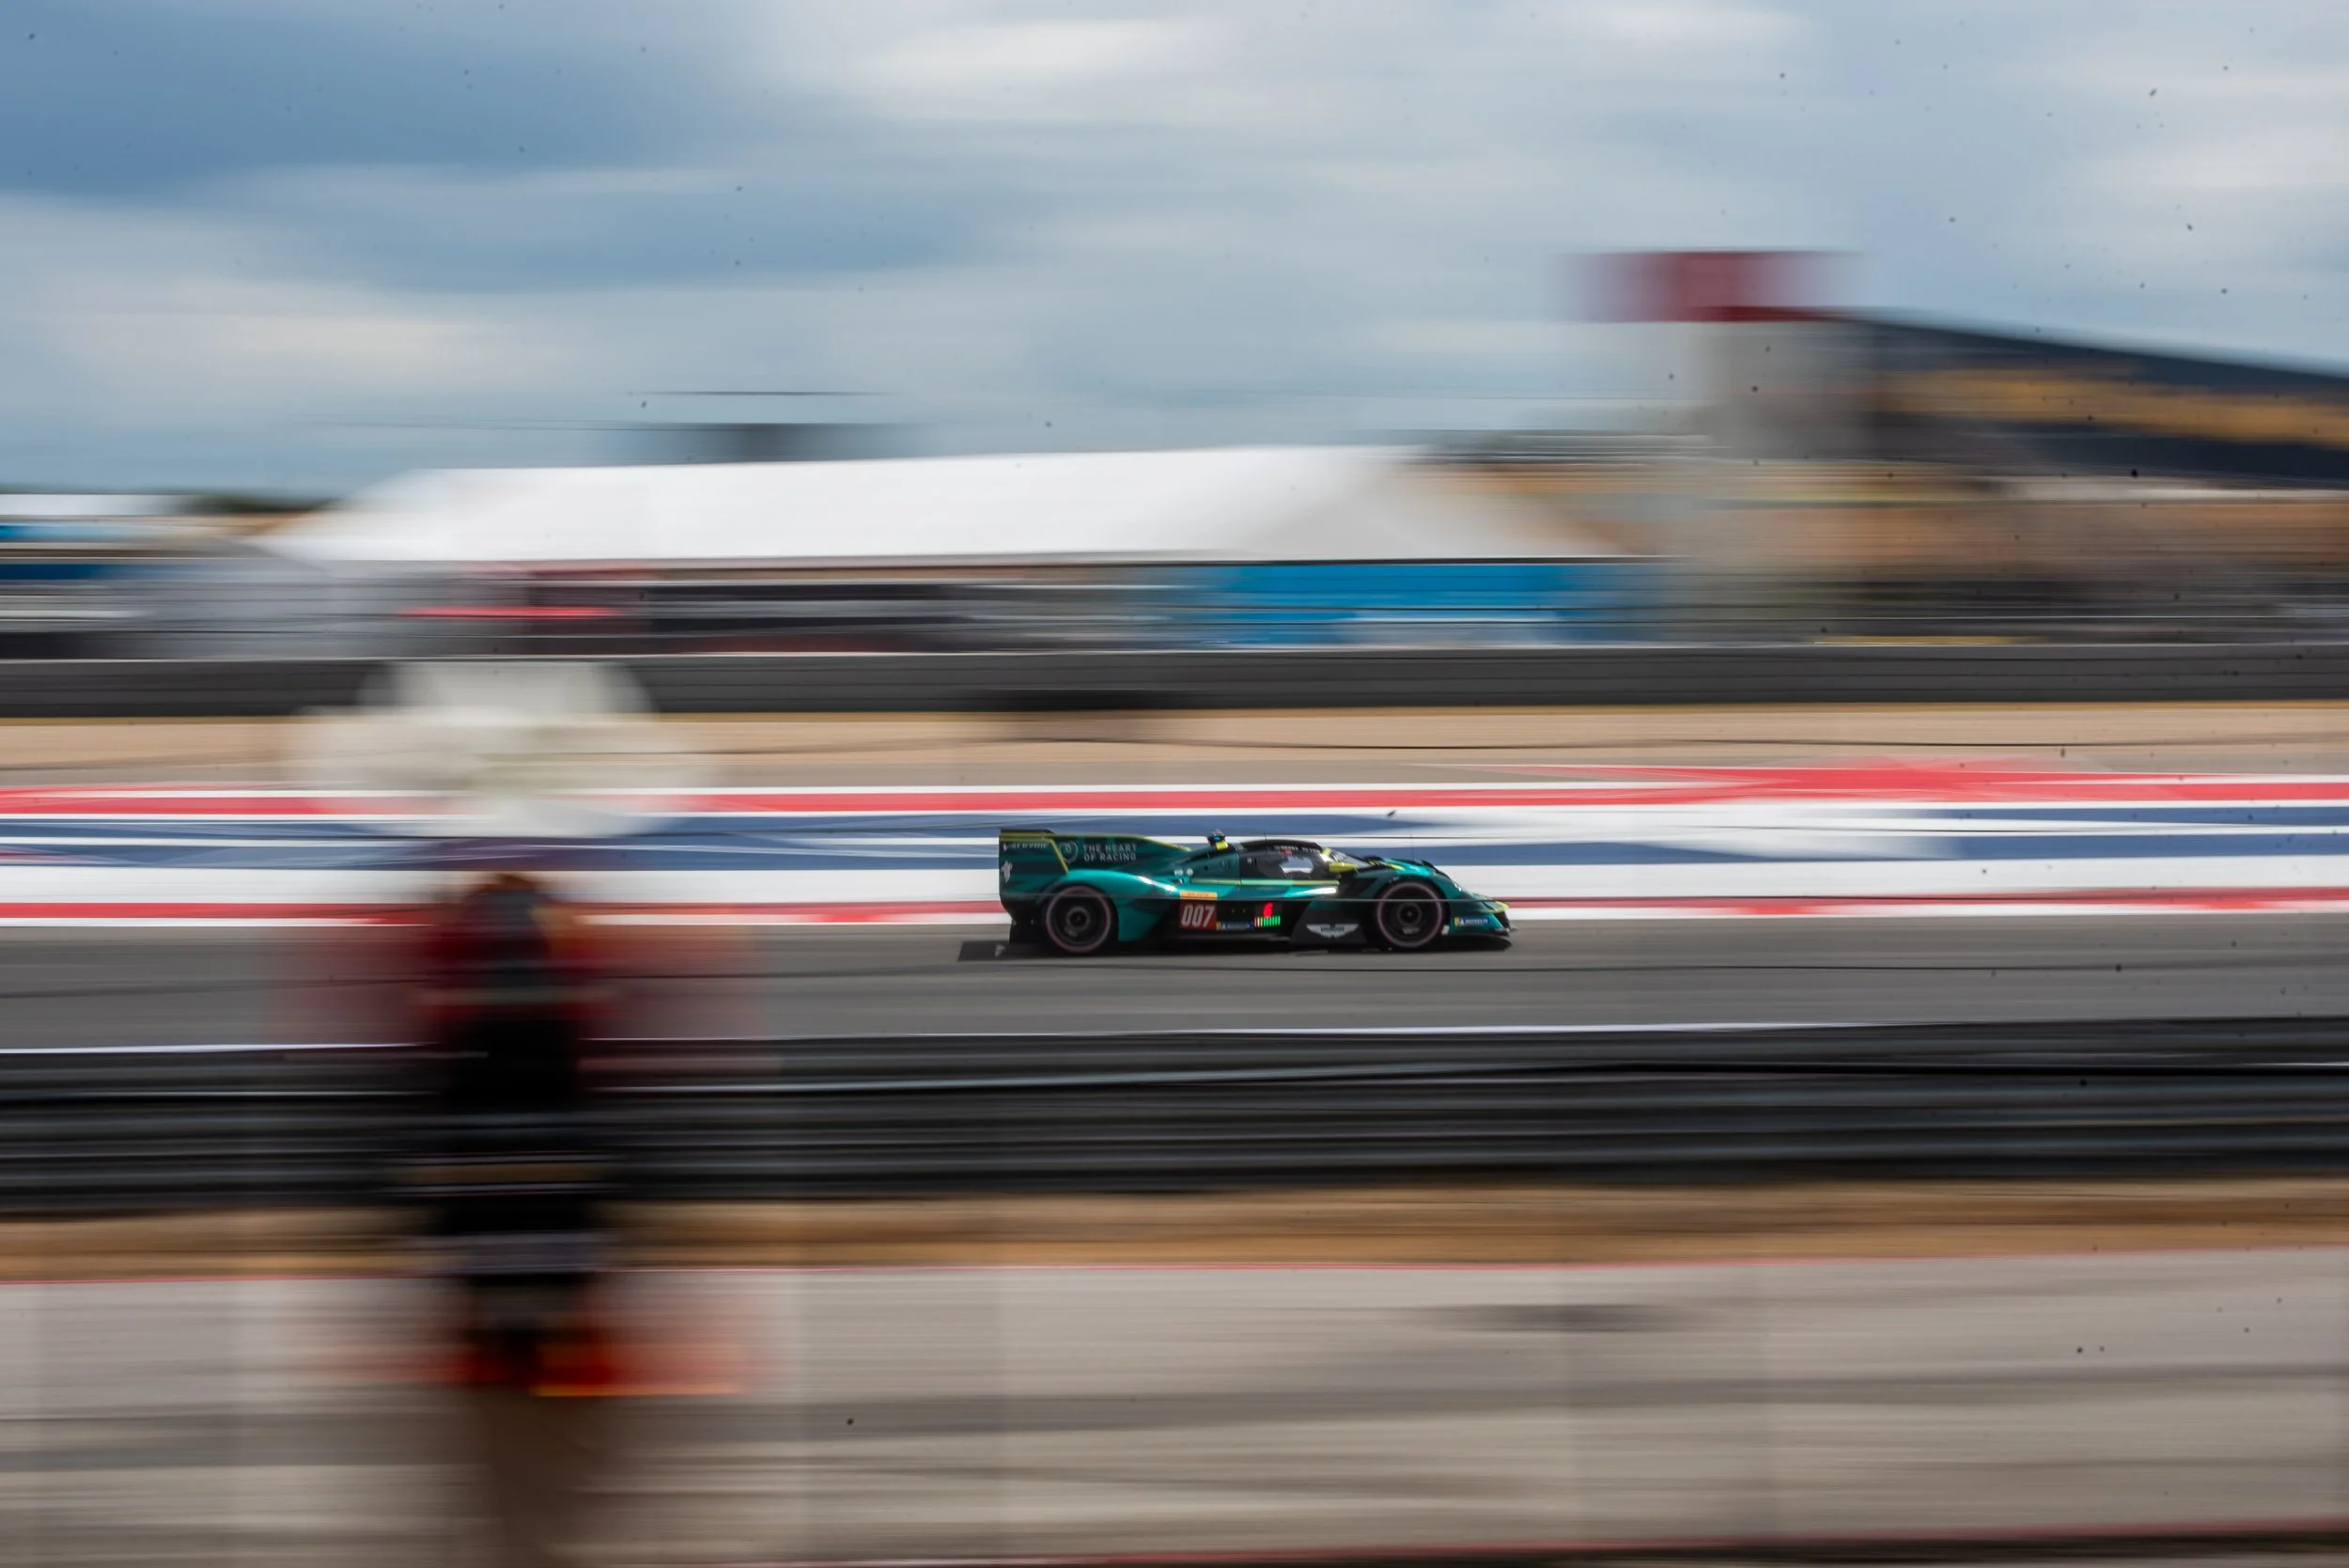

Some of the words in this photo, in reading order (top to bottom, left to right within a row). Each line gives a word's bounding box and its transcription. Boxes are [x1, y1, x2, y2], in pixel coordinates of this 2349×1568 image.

[1083, 843, 1101, 853] THE
[1105, 843, 1137, 852] HEART
[1083, 852, 1096, 862] OF
[1099, 851, 1137, 862] RACING
[1181, 904, 1215, 927] 007
